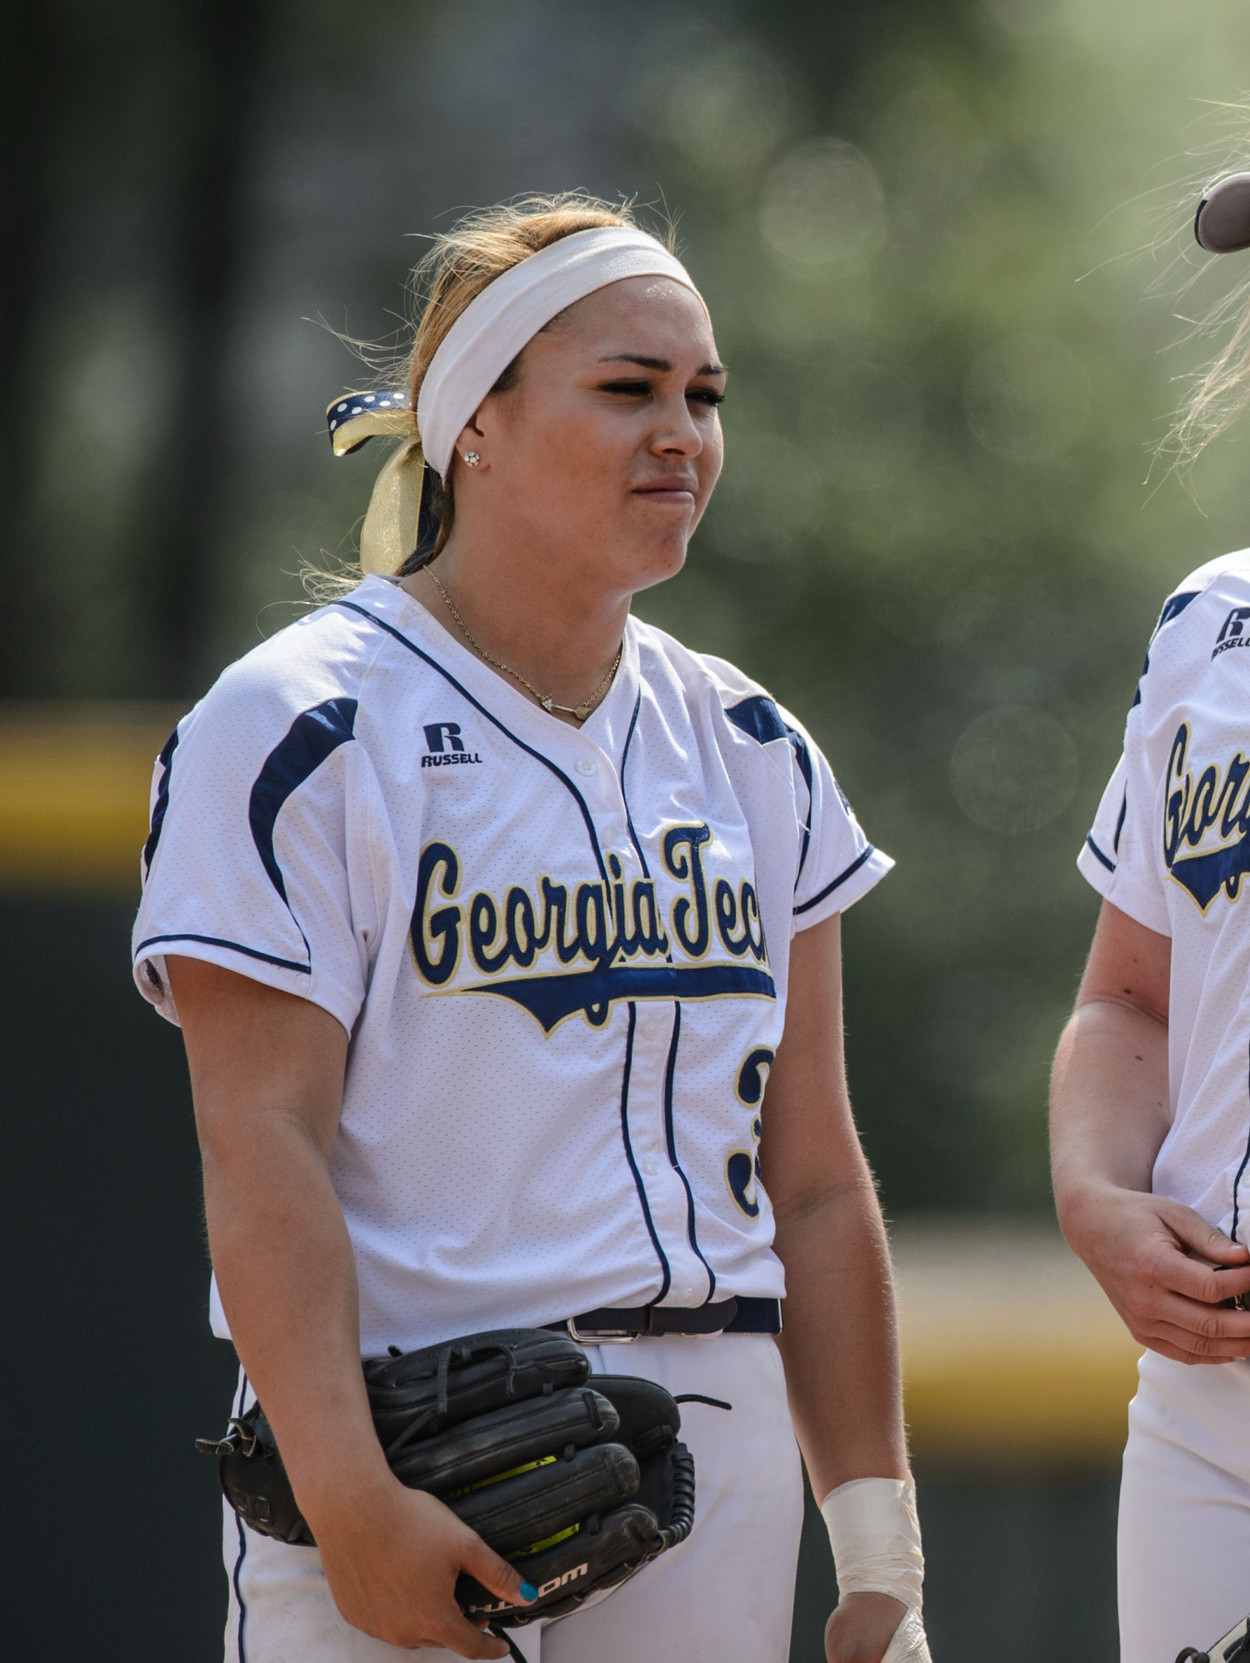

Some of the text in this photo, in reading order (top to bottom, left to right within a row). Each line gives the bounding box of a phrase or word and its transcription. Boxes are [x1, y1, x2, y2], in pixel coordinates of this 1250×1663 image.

[421, 753, 483, 768] RUSSELL
[407, 820, 768, 1031] Georgia Tec
[469, 1562, 589, 1613] WOTH
